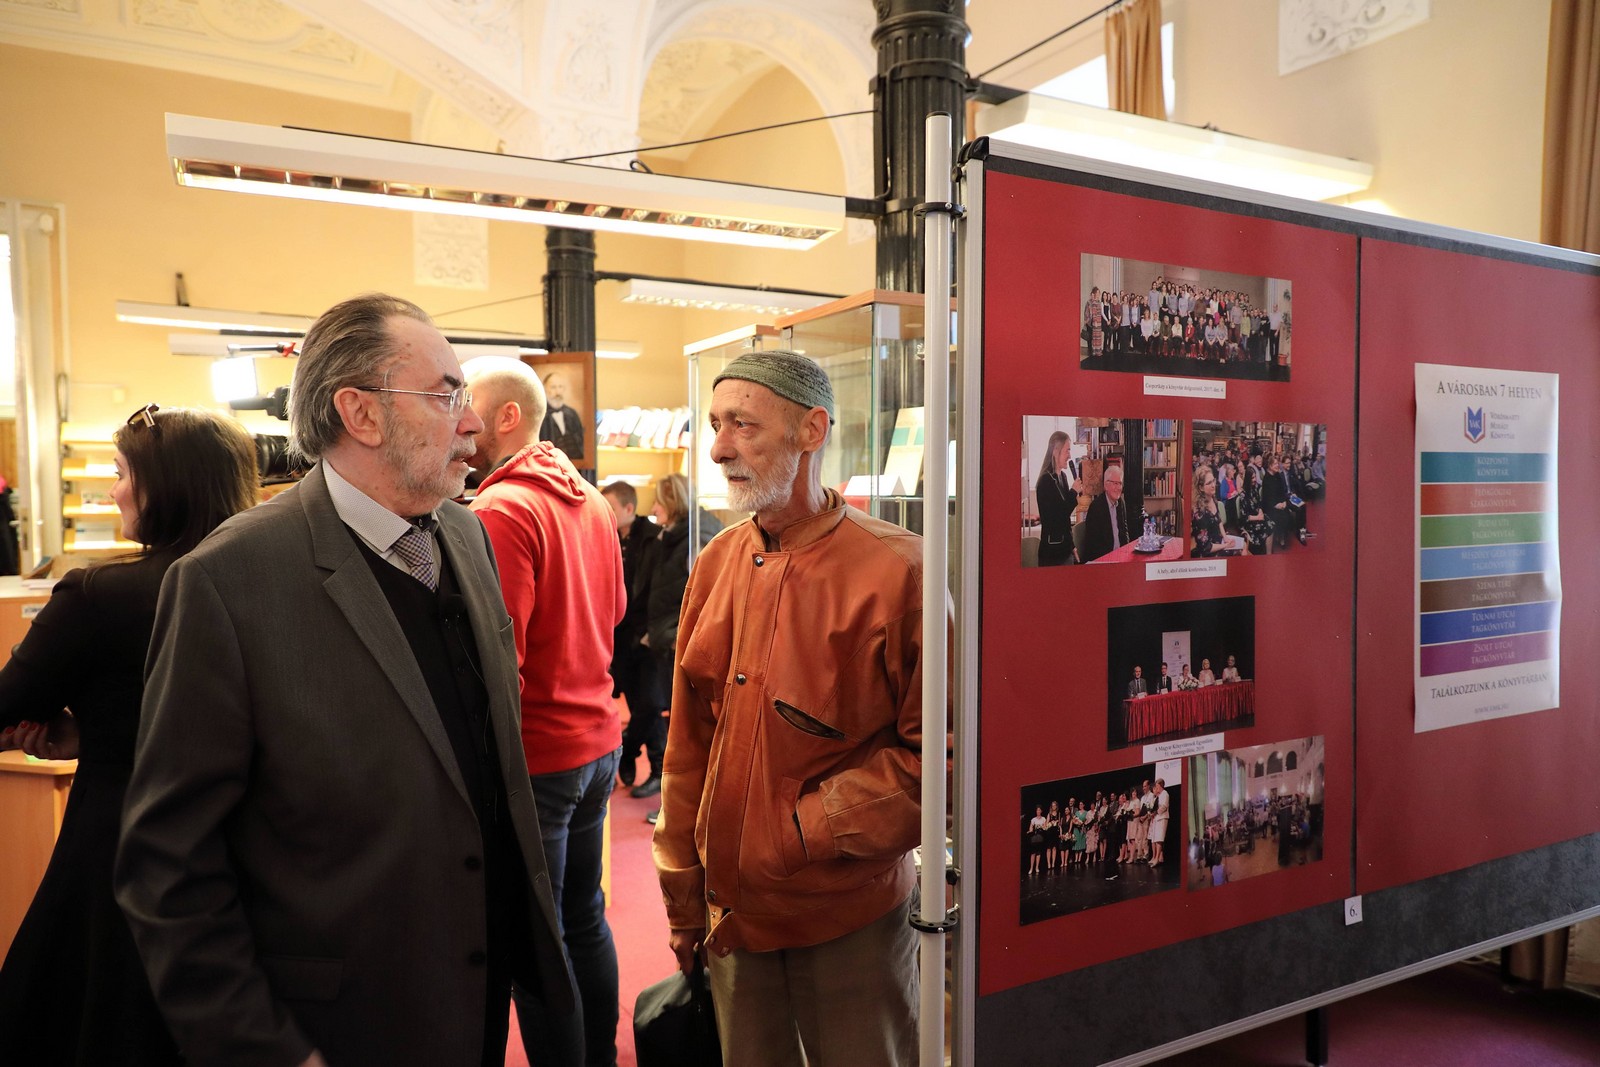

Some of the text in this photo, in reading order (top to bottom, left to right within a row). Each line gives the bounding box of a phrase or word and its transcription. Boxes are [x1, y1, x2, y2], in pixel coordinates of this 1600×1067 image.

[1437, 380, 1542, 399] A VÁROSBAN 7 HELYEN
[1431, 681, 1491, 699] TALÁLKOZZUNK
